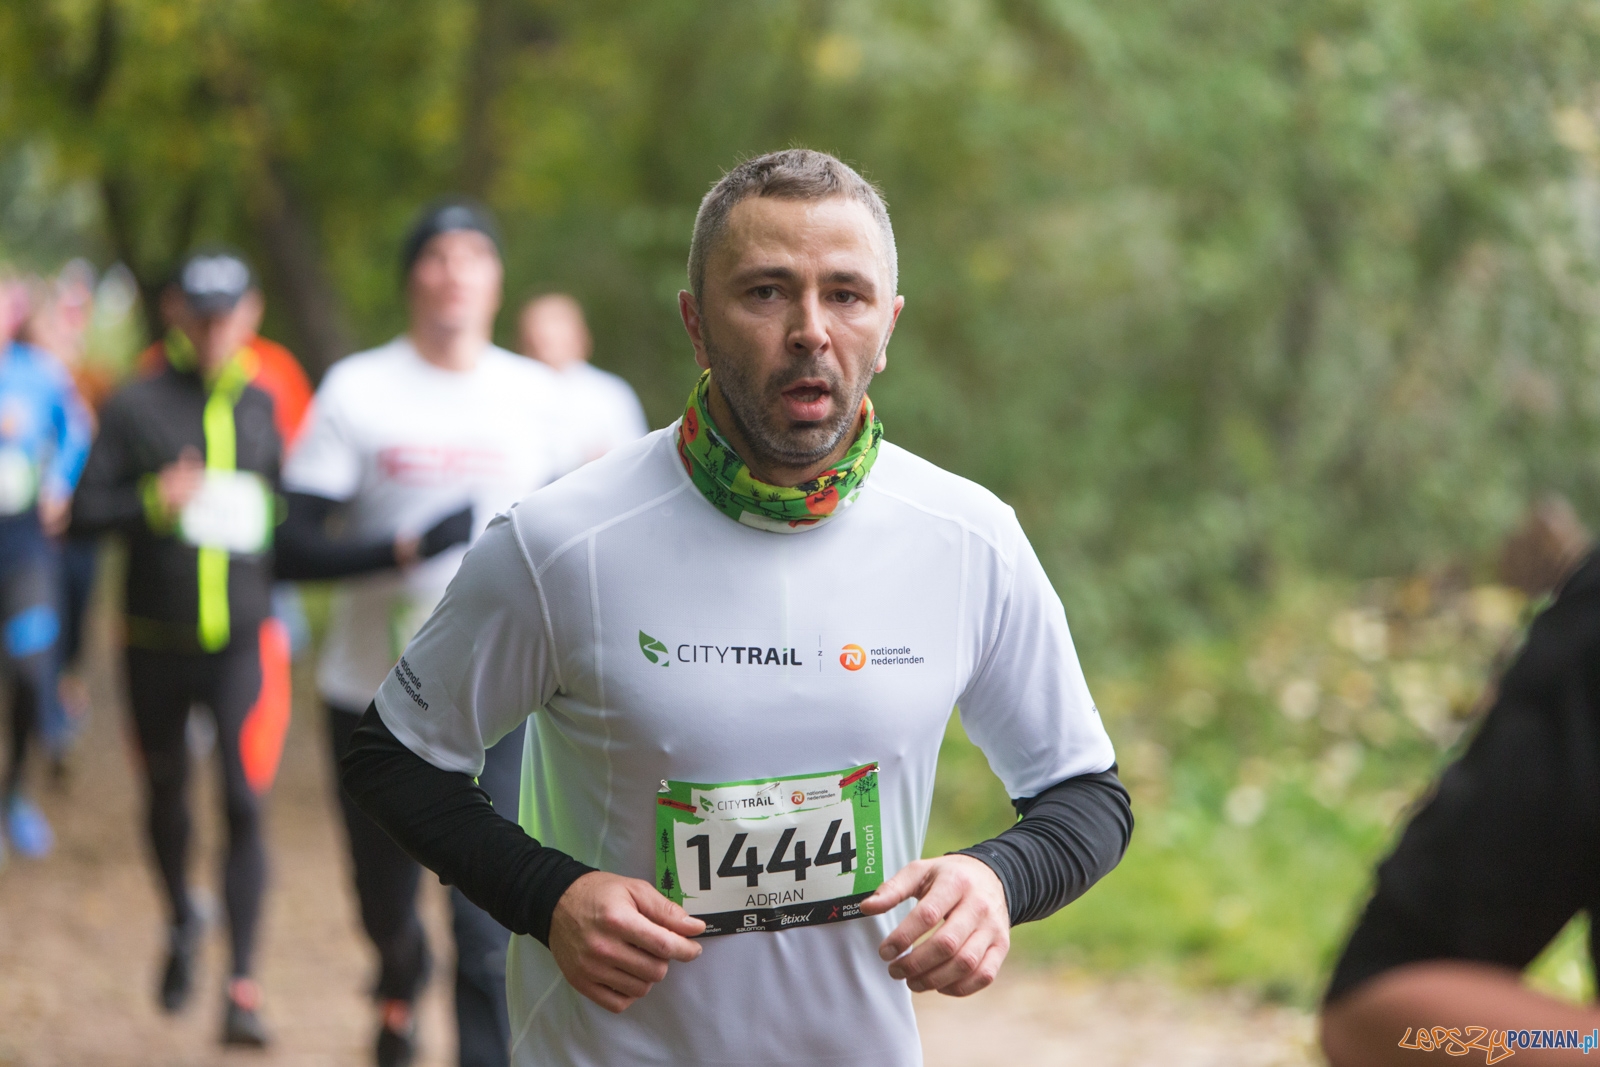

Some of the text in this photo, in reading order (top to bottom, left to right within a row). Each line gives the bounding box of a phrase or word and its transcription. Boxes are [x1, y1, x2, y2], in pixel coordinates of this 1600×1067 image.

[870, 645, 911, 656] nationale
[870, 654, 924, 666] nederlanden
[686, 818, 857, 891] 1444
[863, 824, 876, 875] Poznań
[745, 888, 804, 907] ADRIAN
